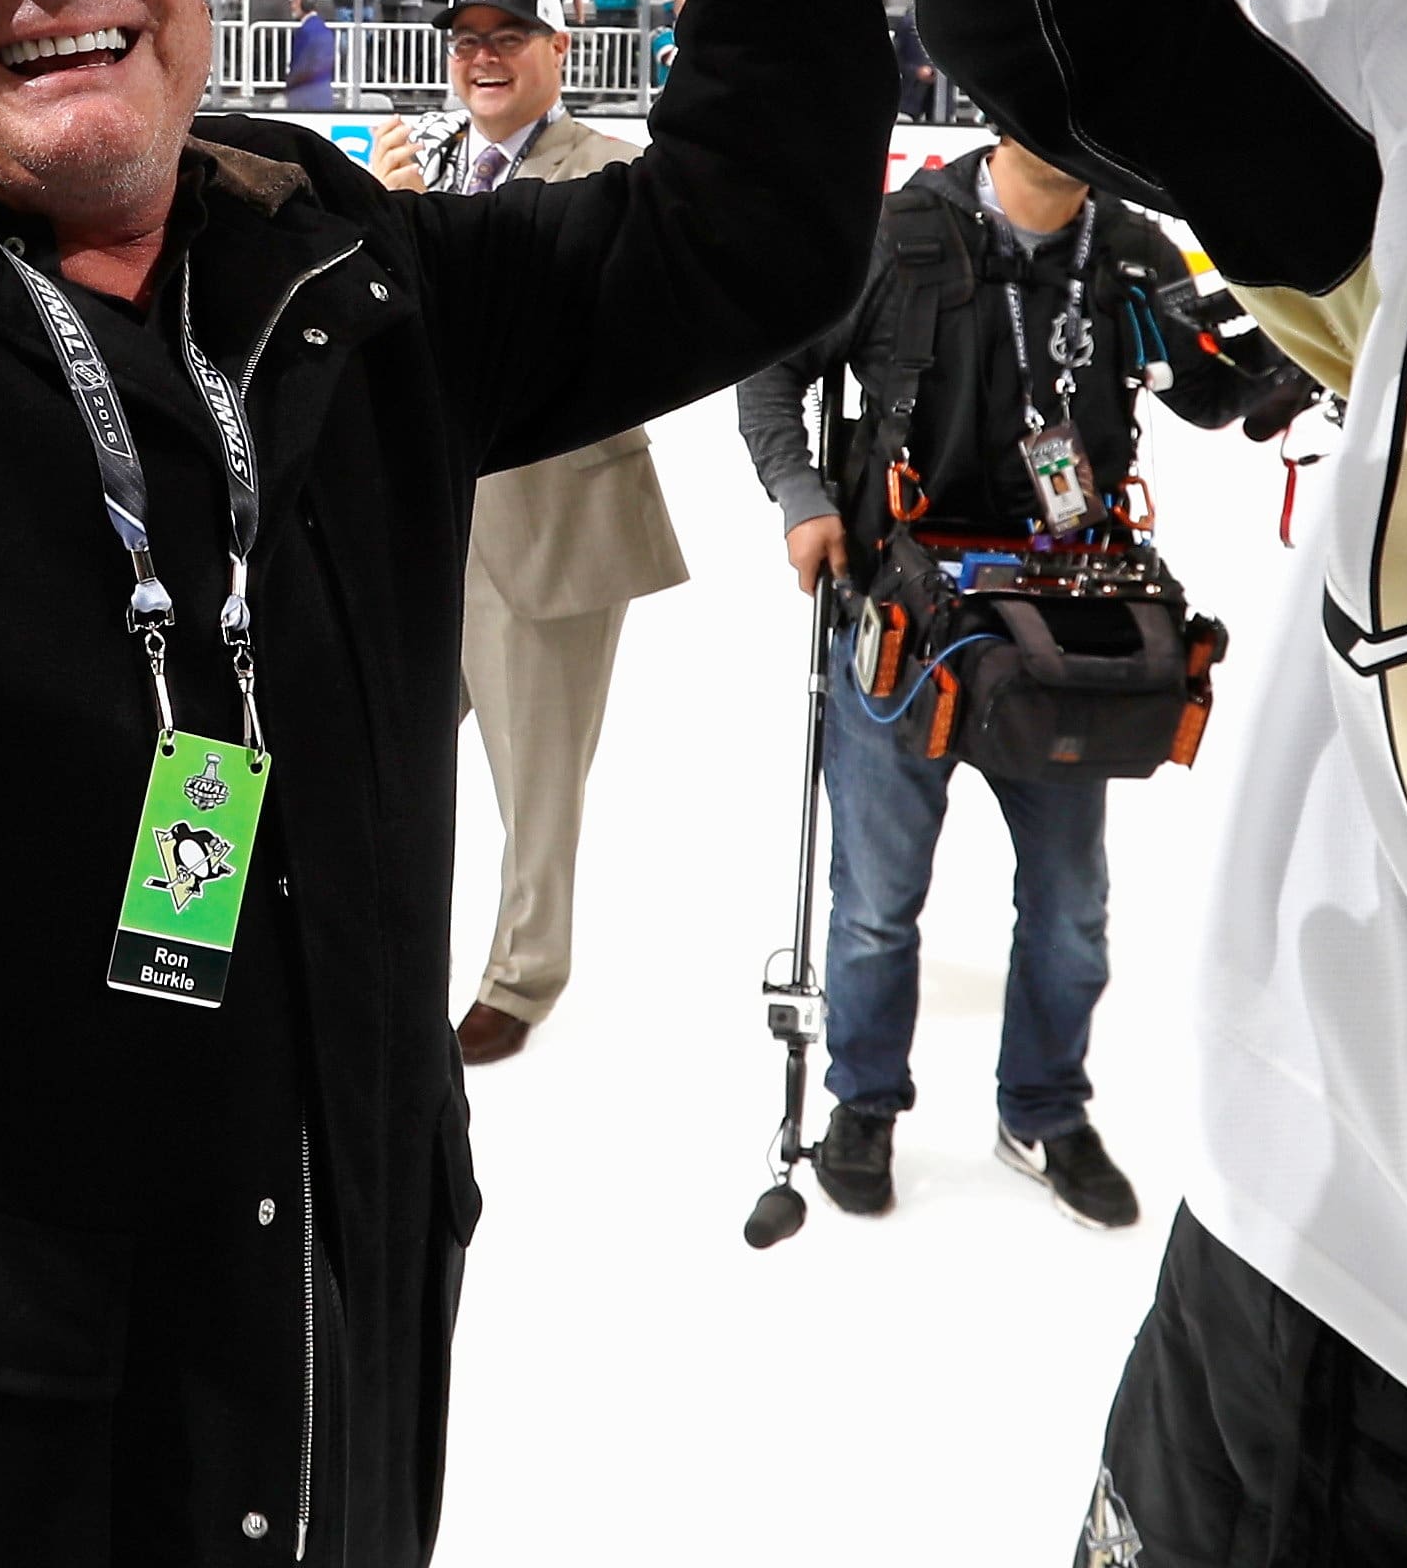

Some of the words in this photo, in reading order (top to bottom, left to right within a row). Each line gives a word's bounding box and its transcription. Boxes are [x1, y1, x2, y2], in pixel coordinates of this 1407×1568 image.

[27, 268, 87, 355] FINAL
[93, 395, 118, 443] 2016
[194, 362, 248, 478] STANLEY
[185, 778, 229, 797] FINAL
[154, 946, 189, 969] Ron
[140, 965, 195, 992] Burkle
